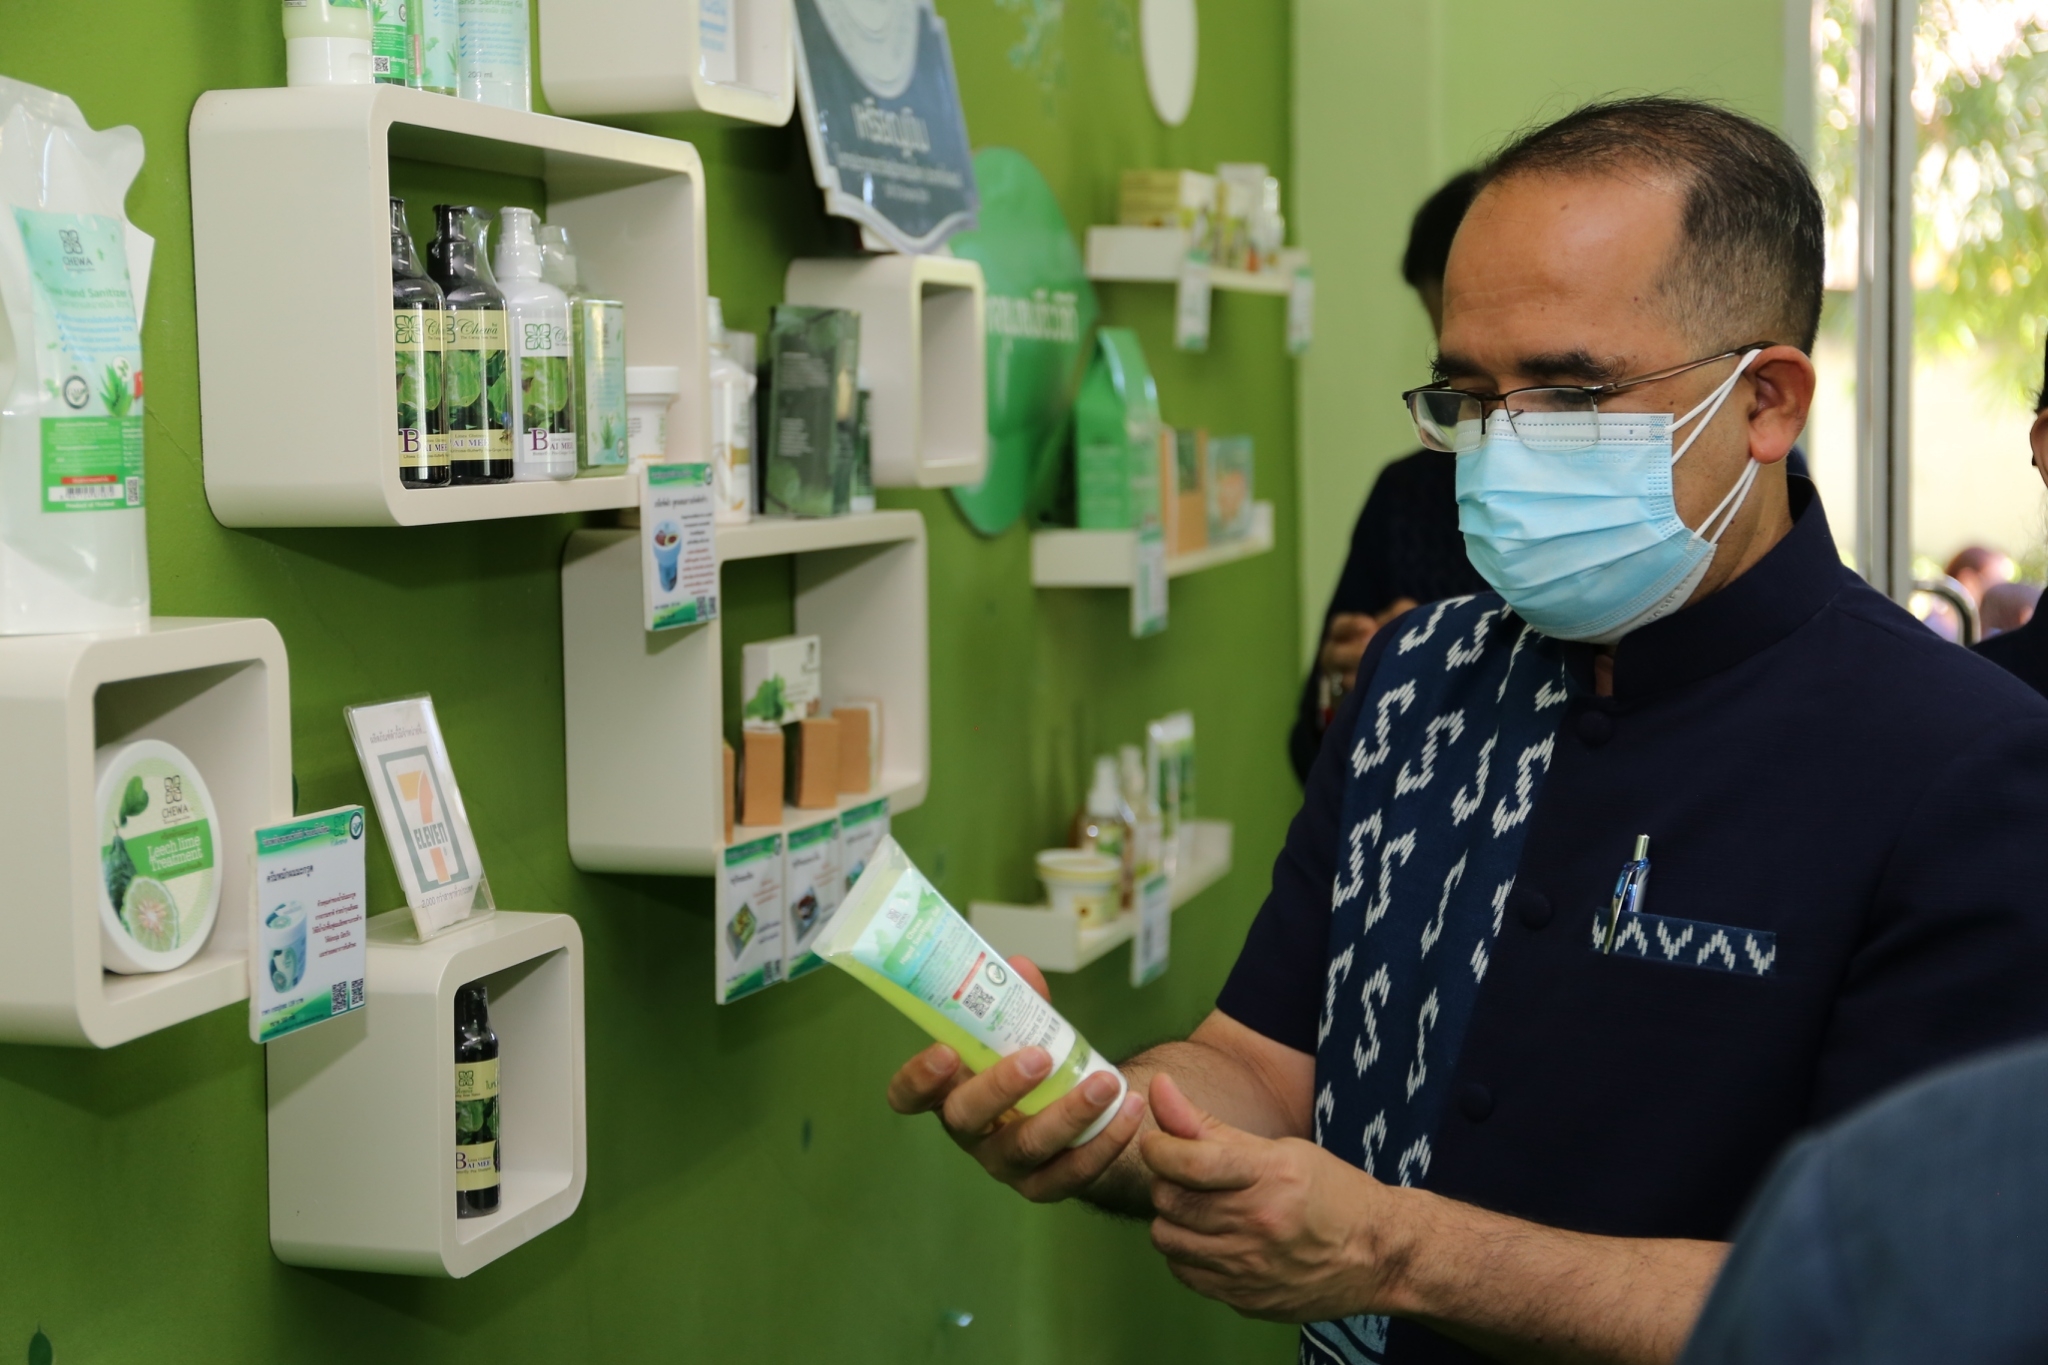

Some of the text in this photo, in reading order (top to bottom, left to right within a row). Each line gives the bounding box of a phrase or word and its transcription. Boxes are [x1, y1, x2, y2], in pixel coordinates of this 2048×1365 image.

[468, 71, 481, 79] 200
[62, 256, 93, 266] CHEWA
[88, 288, 127, 298] Sanitizer
[457, 318, 498, 335] Chewa
[162, 804, 190, 819] CHEWA
[147, 836, 200, 859] Leech lime
[150, 848, 203, 872] Treatment
[421, 894, 436, 908] 2,000
[905, 918, 924, 940] Chewa
